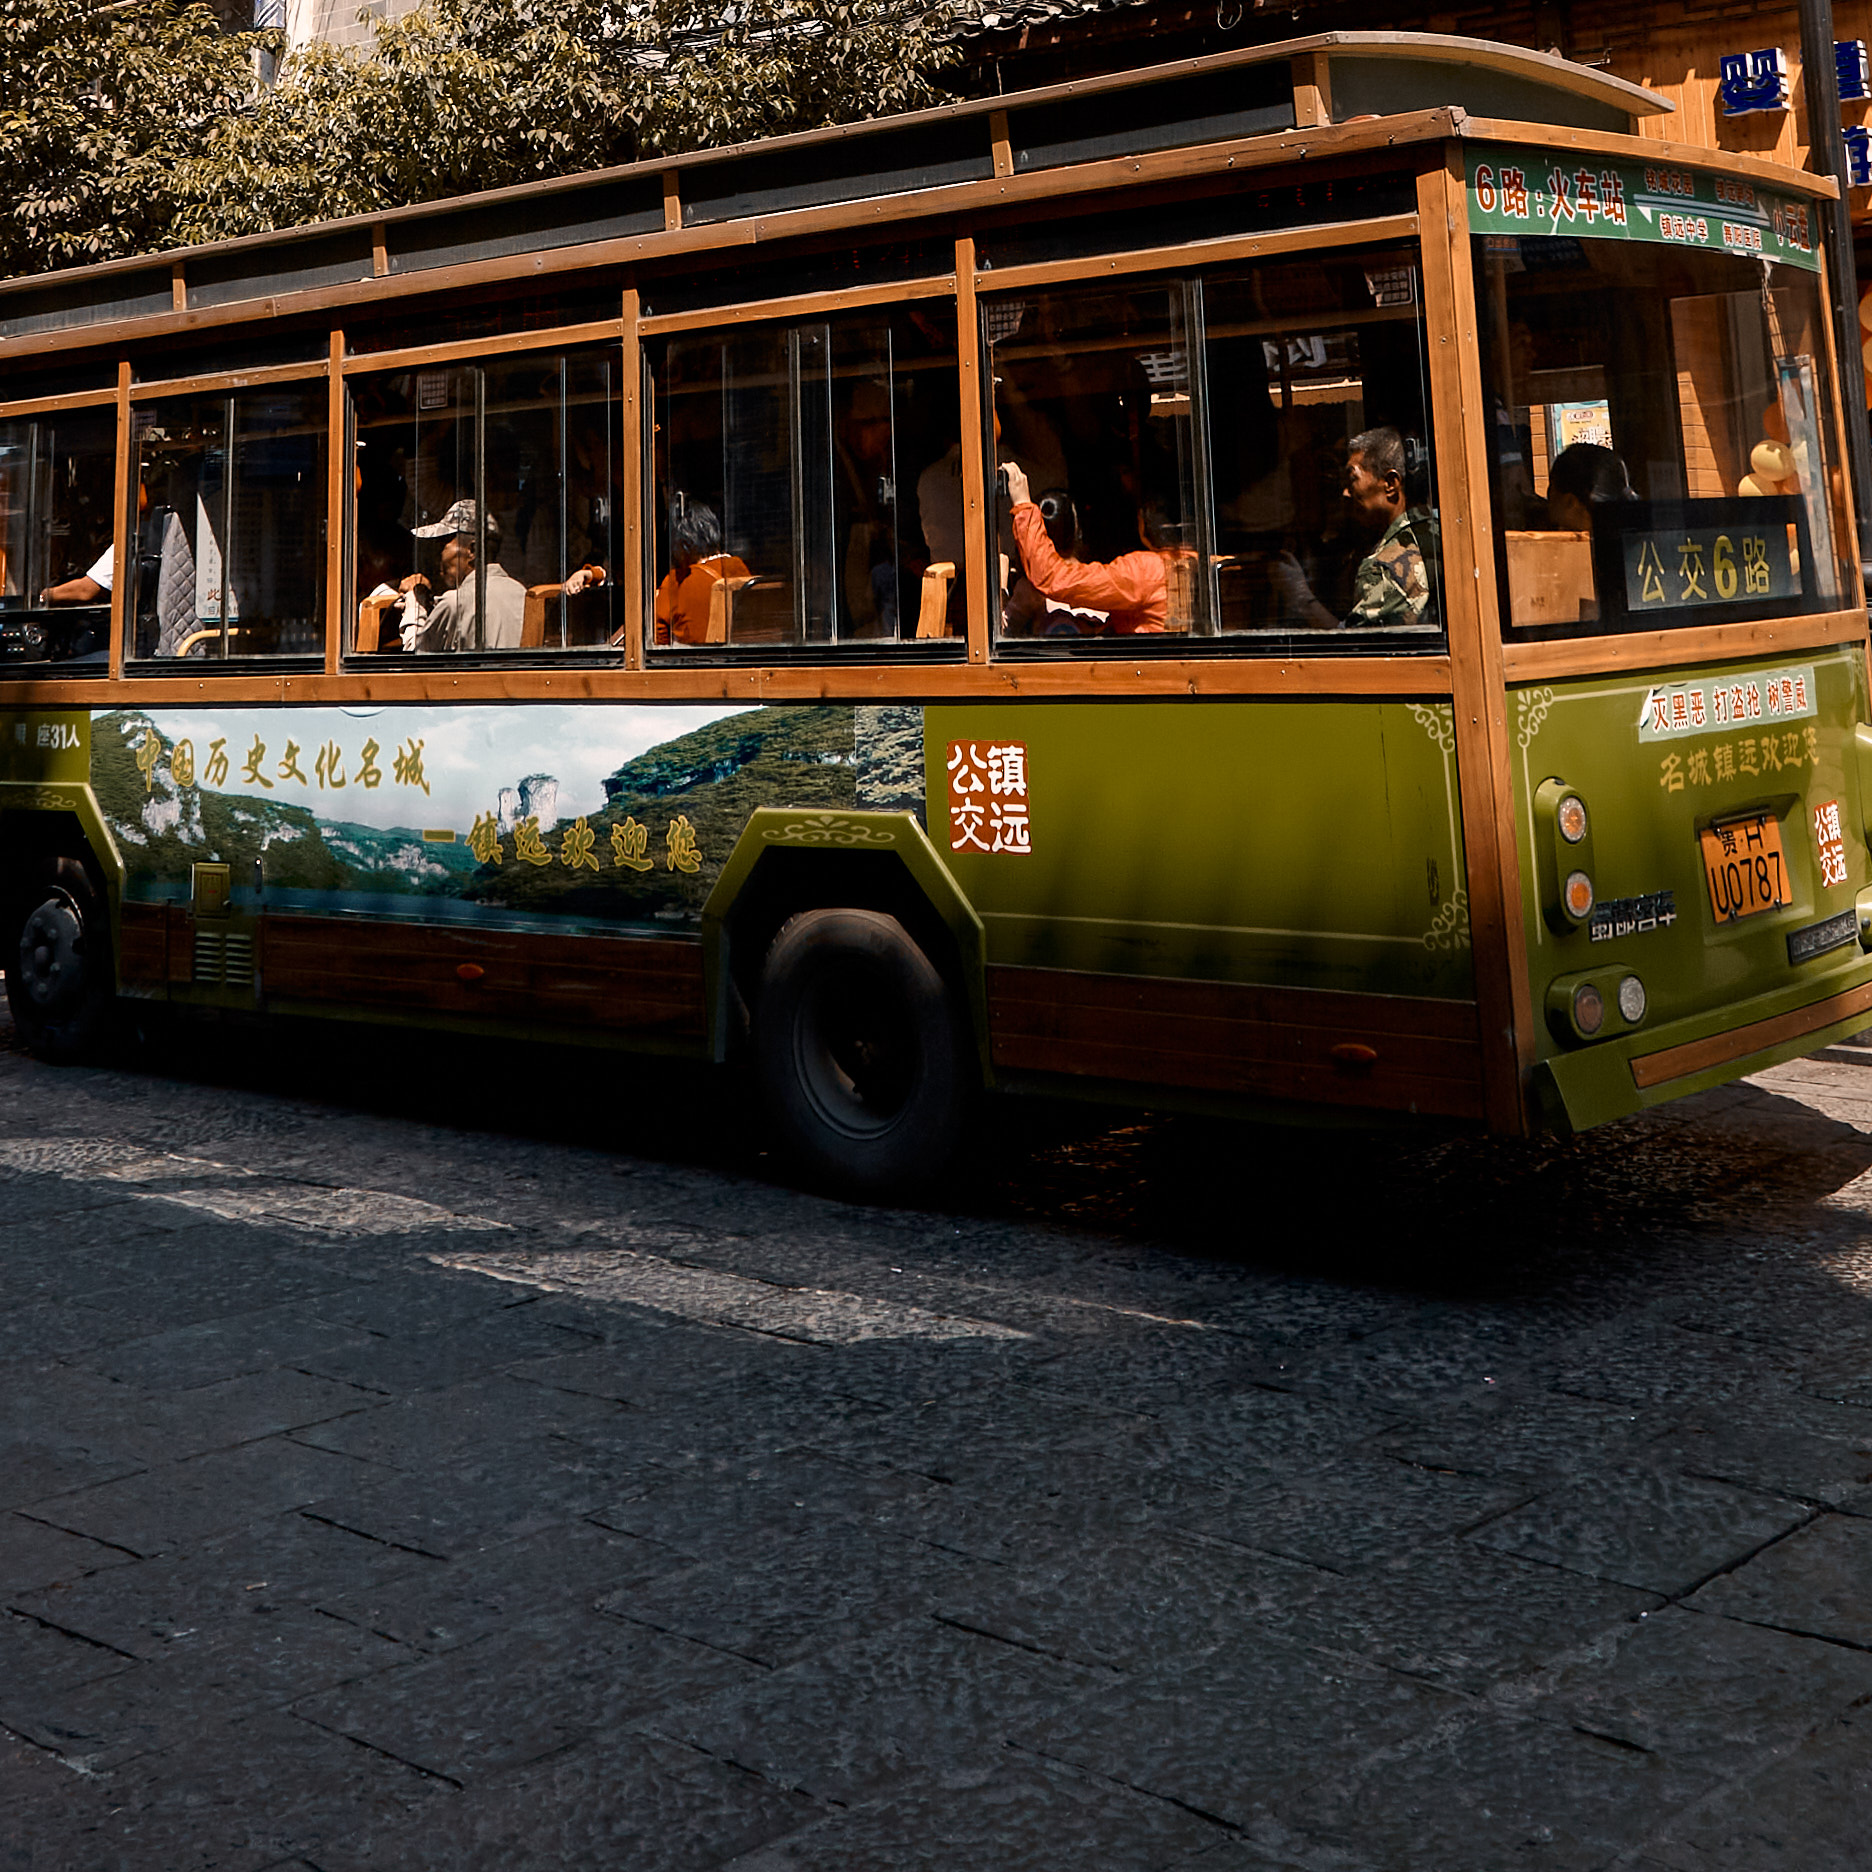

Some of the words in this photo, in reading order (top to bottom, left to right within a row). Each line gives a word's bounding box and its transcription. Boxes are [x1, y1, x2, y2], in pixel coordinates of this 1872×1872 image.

[1659, 212, 1709, 243] 镇远中学
[1637, 535, 1771, 603] 公交6路
[1651, 689, 1707, 732] 灭黑恶
[1713, 682, 1762, 724] 打盗抢
[135, 728, 430, 796] 中国历史文化名城
[1659, 725, 1820, 794] 名城镇远欢迎您
[1711, 851, 1782, 915] U0787
